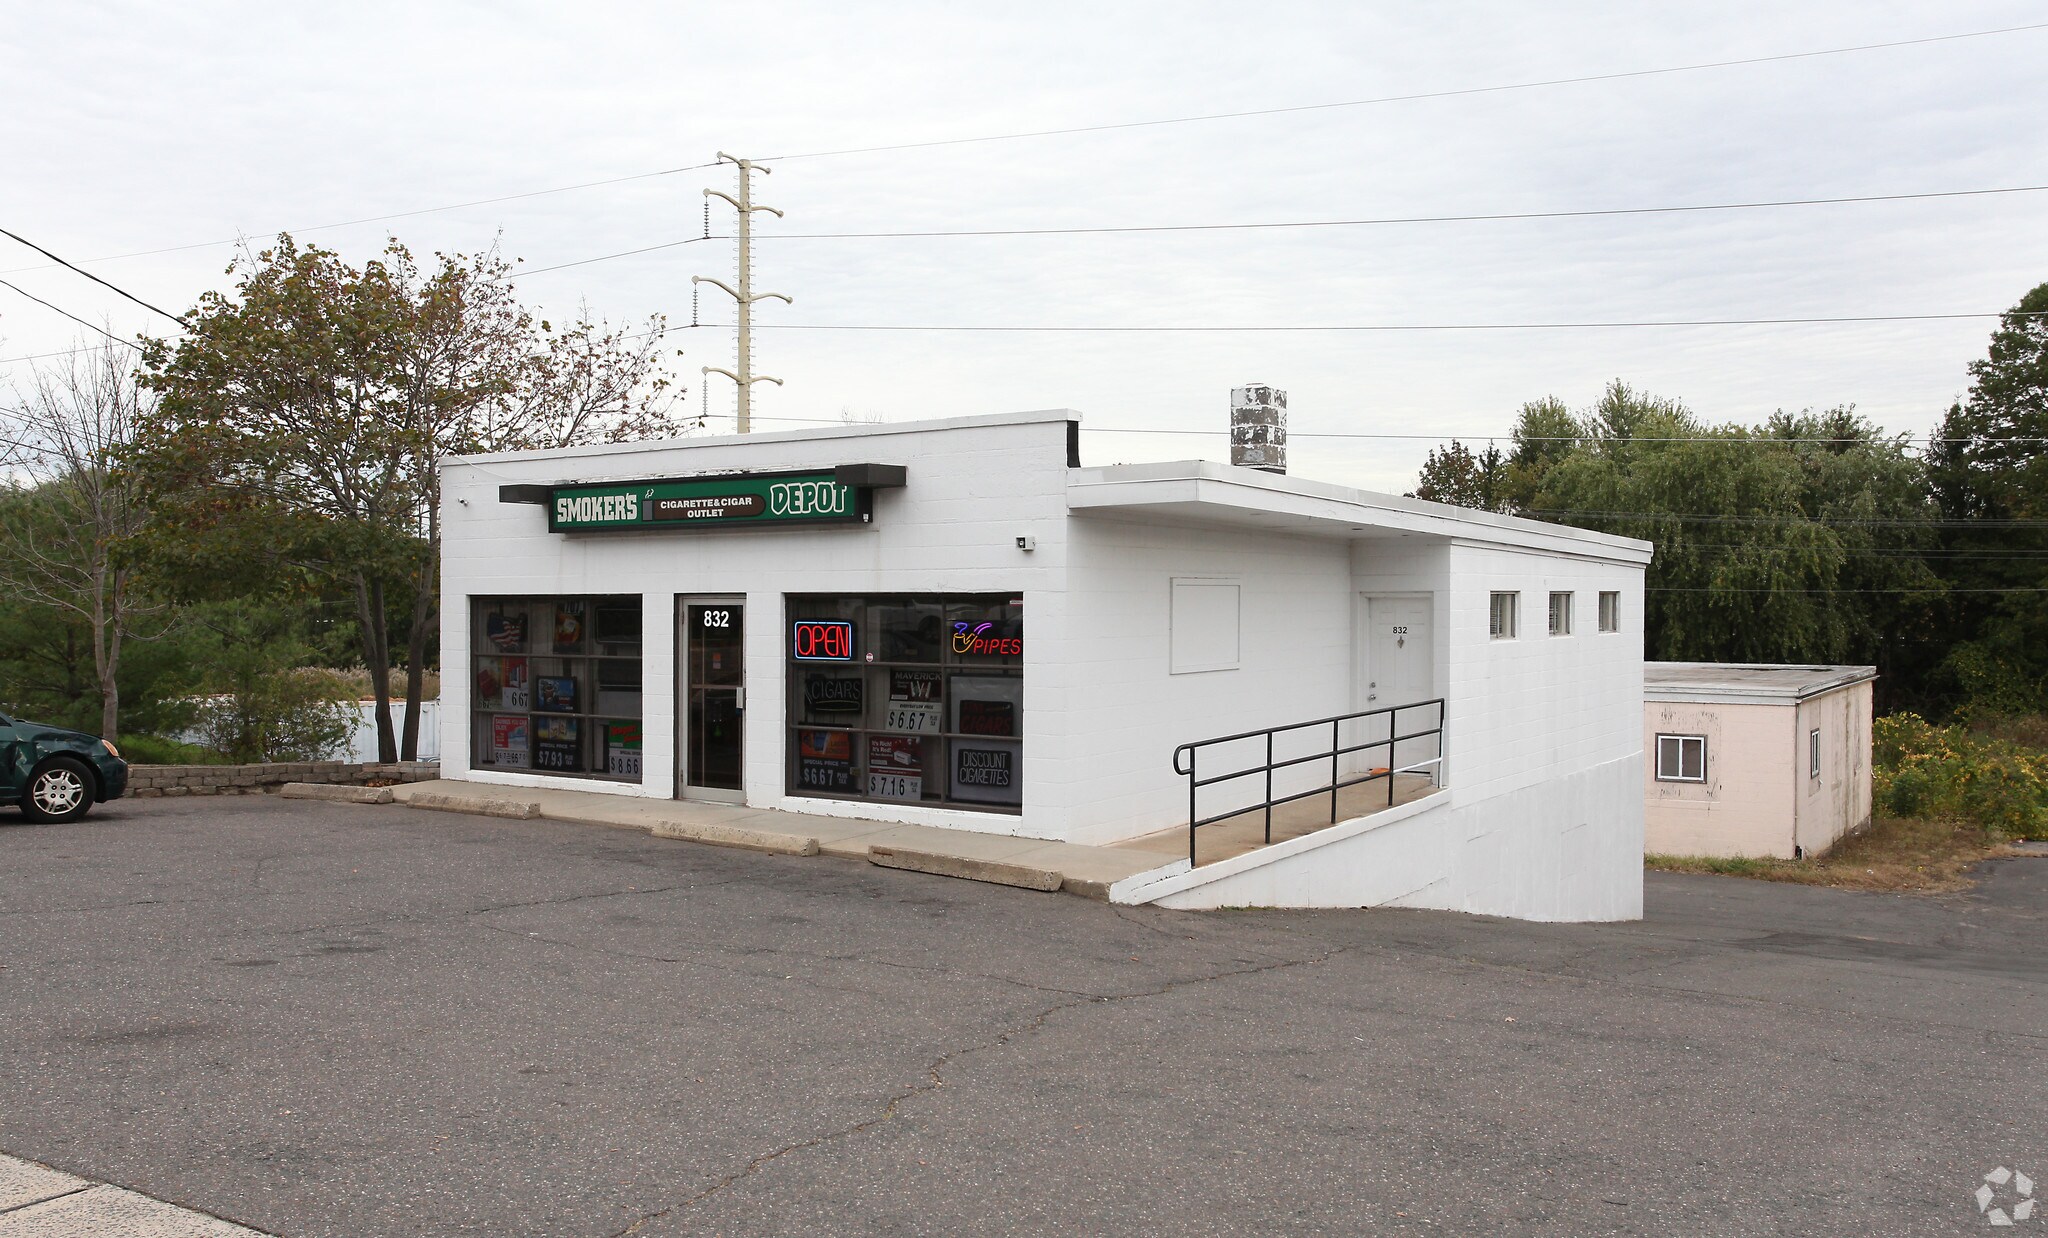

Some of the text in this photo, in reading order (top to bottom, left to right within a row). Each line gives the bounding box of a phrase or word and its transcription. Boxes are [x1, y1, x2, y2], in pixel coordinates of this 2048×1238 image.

[769, 481, 847, 515] DEPOT
[557, 493, 637, 522] SMOKER'S
[687, 509, 724, 518] OUTLET
[703, 610, 730, 627] 832
[1392, 626, 1408, 634] 832
[797, 625, 849, 657] OPEN
[973, 638, 1021, 655] PIPES
[895, 672, 942, 681] MAVERICK
[811, 680, 861, 700] CIGARS
[963, 751, 1007, 769] DISCOUNT
[959, 767, 1009, 785] CIGARETTES
